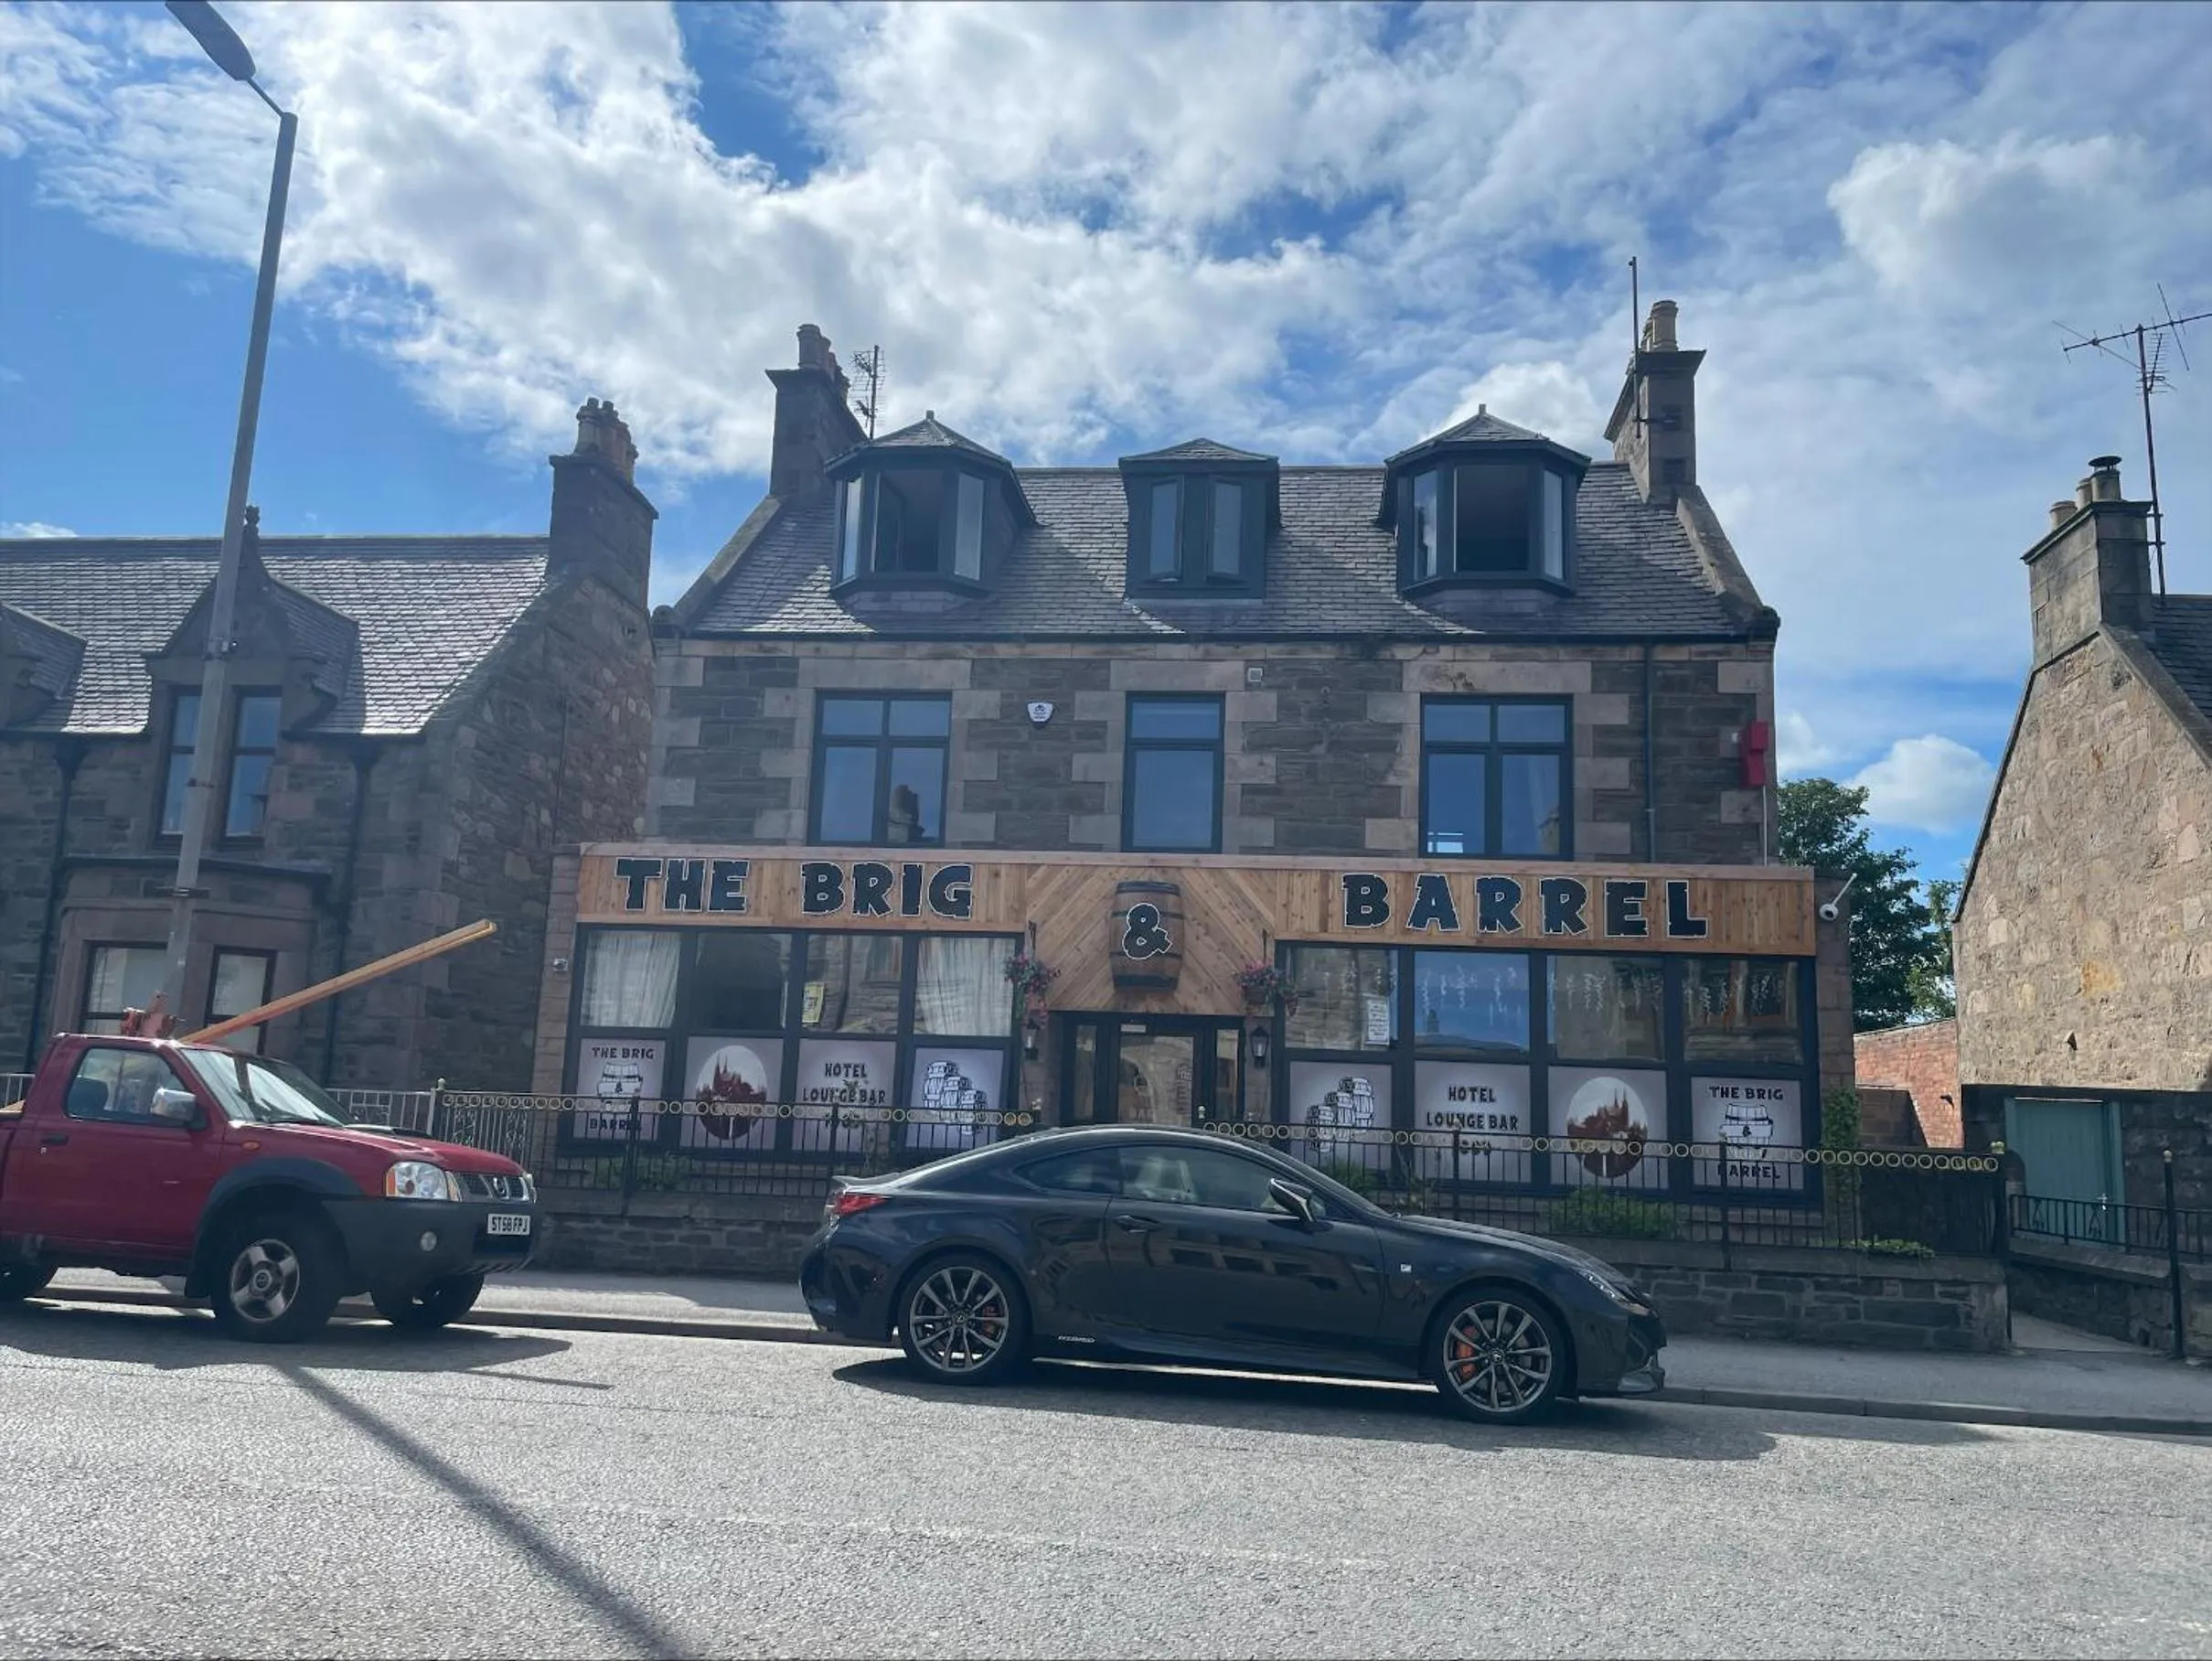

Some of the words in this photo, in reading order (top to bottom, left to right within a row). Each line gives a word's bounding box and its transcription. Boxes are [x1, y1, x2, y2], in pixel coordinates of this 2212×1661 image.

[614, 857, 750, 913] THE
[801, 862, 974, 919] BRIG
[1122, 903, 1173, 960] &
[1341, 873, 1708, 938] BARREL
[592, 1046, 617, 1059] THE
[622, 1047, 655, 1060] BRIG
[825, 1063, 867, 1078] HOTEL
[860, 1088, 886, 1105] BAR
[1448, 1086, 1496, 1103] HOTEL
[1709, 1086, 1739, 1099] THE
[1745, 1087, 1784, 1101] BRIG
[1427, 1111, 1484, 1130] LOUNGE
[1489, 1114, 1518, 1131] BAR
